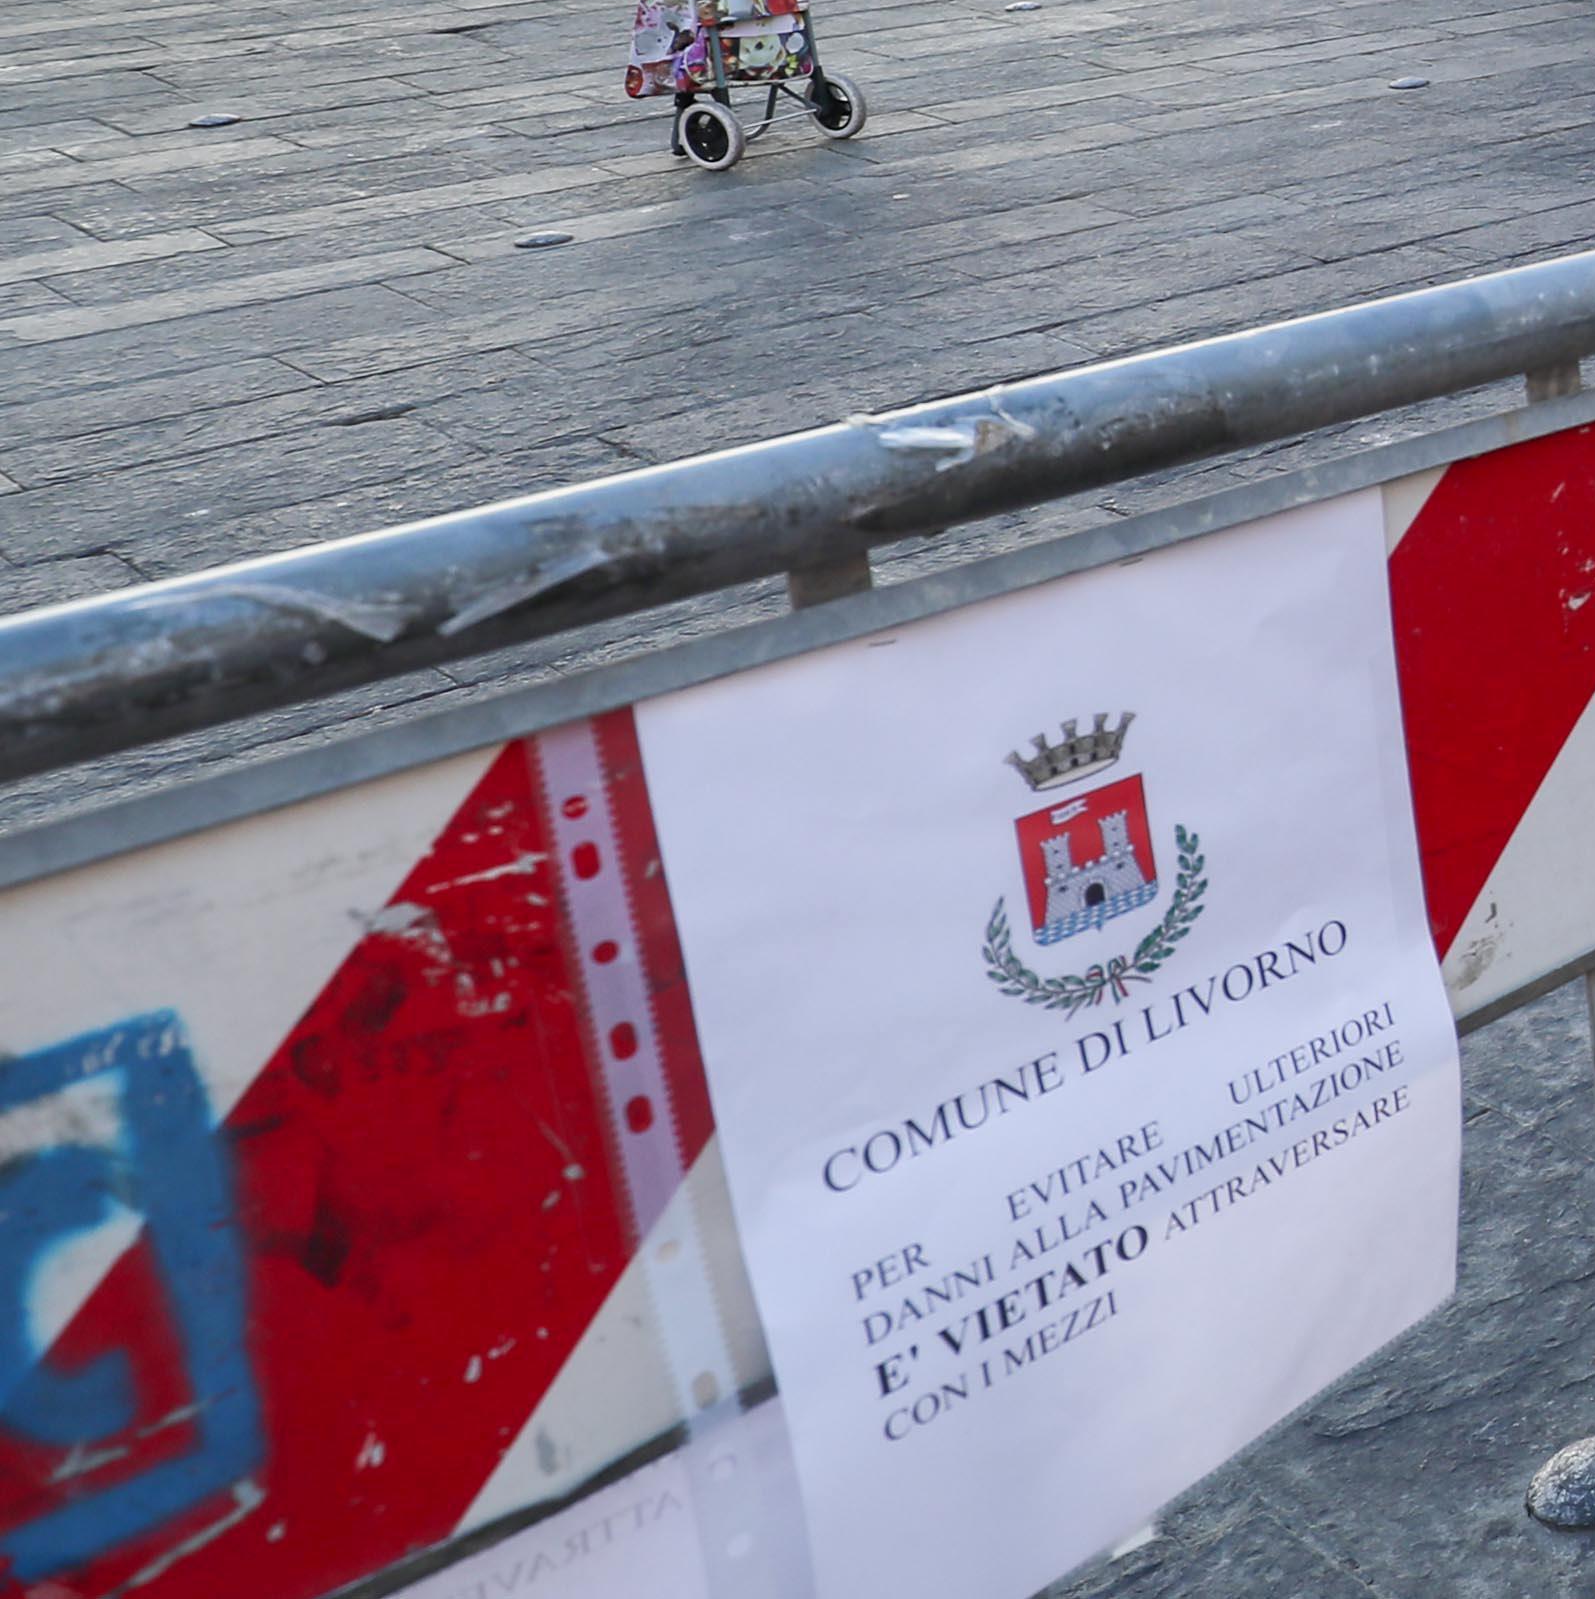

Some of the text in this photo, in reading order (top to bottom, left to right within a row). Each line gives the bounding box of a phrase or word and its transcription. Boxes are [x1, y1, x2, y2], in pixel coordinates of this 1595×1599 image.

[822, 919, 1348, 1193] COMUNE DI LIVORNO
[850, 1001, 1398, 1302] PER EVITARE ULTERIORI
[861, 1040, 1406, 1347] DANNI ALLA PAVIMENTAZIONE
[874, 1084, 1412, 1399] E' VIETATO ATTRAVERSARE
[884, 1289, 1120, 1442] CON I MEZZI
